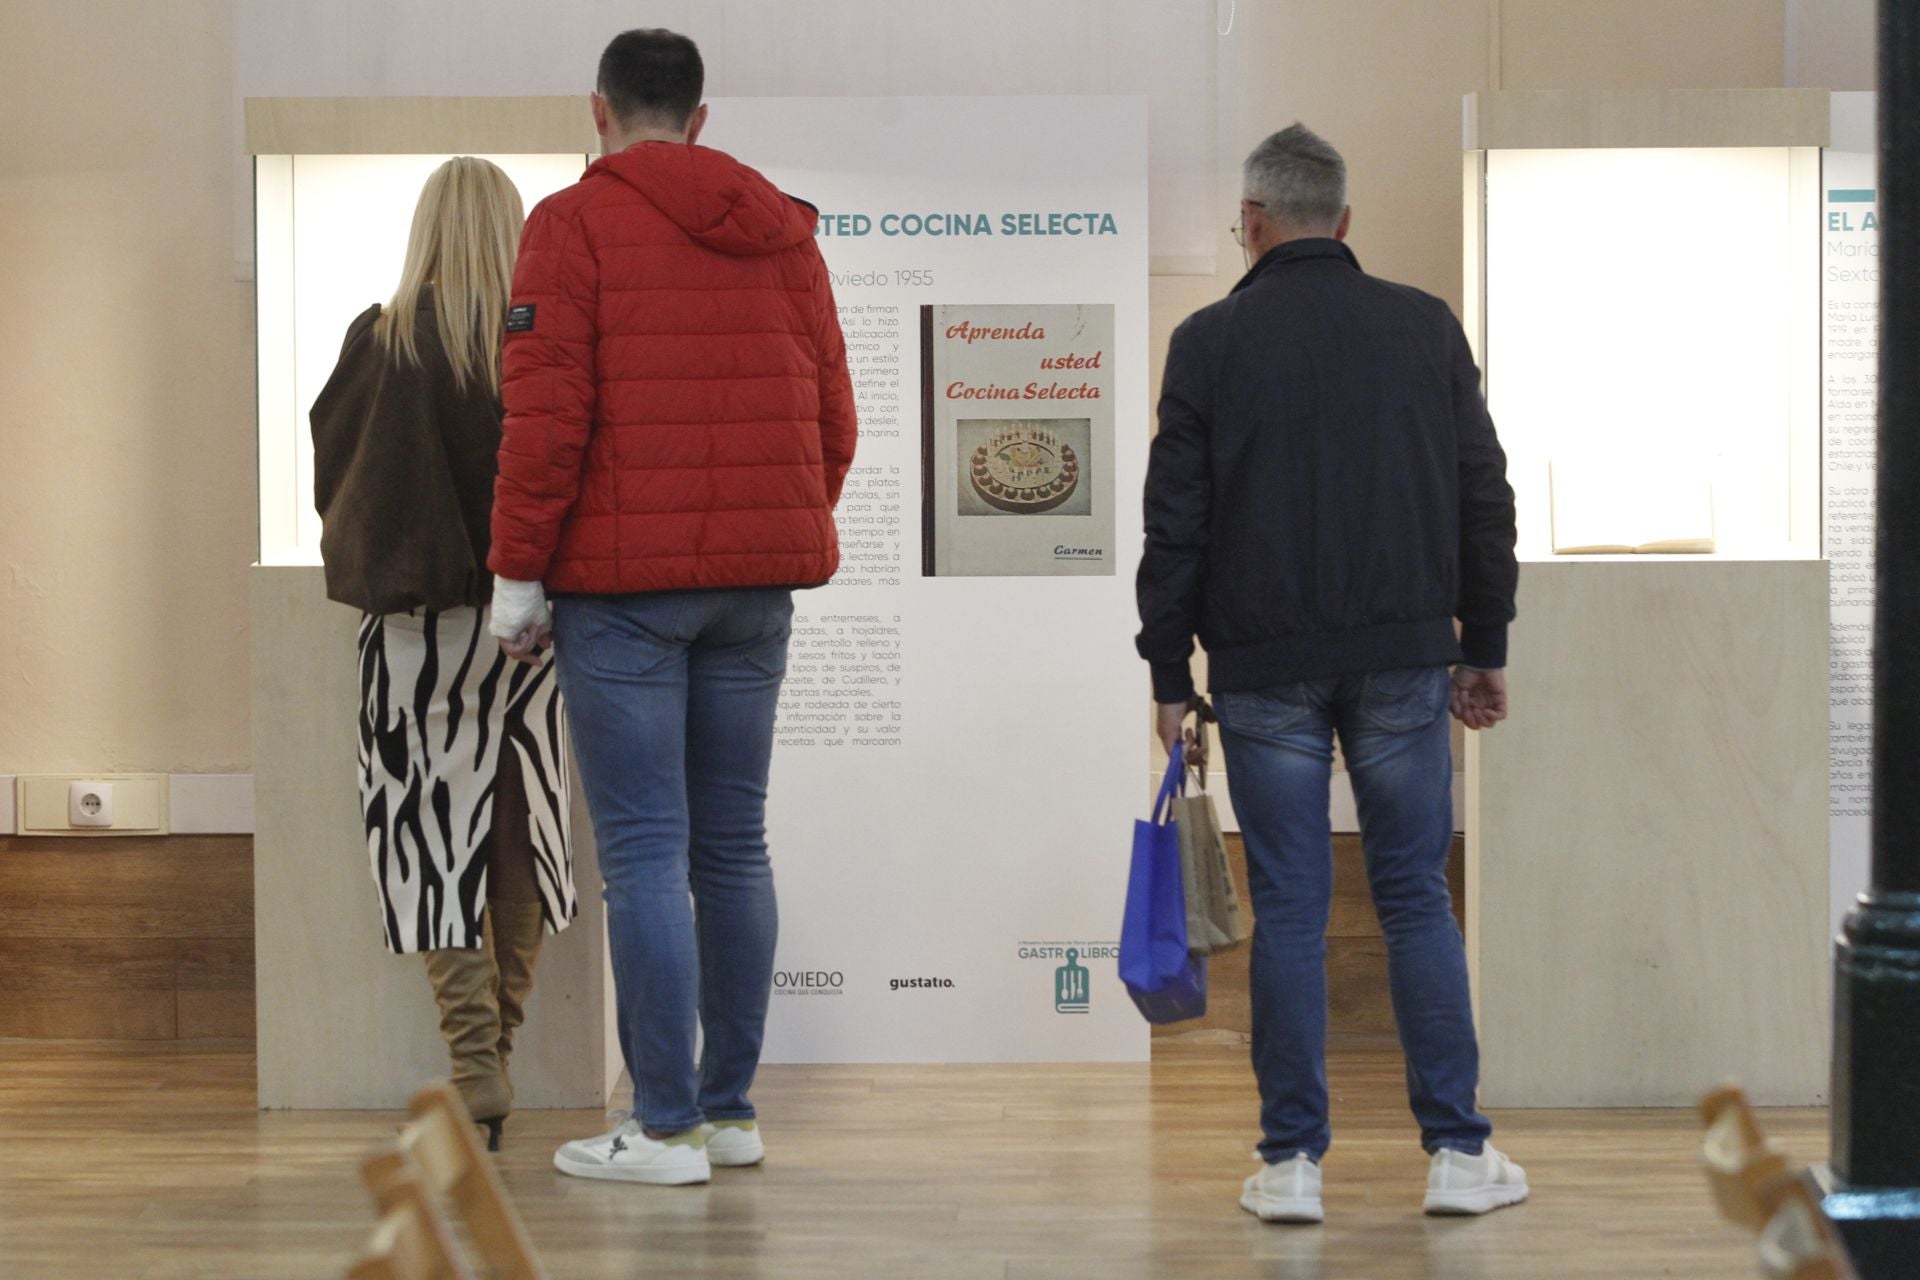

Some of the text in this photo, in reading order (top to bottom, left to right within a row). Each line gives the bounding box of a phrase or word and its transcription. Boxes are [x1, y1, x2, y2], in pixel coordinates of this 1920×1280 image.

[880, 213, 992, 236] COCINA
[1000, 213, 1118, 236] SELECTA
[1828, 211, 1879, 231] EL A
[894, 270, 934, 286] 1955
[851, 304, 864, 313] de
[867, 304, 899, 313] firman
[879, 317, 899, 326] hizo
[945, 320, 1046, 345] Aprenda
[1828, 324, 1847, 334] 1919
[1854, 326, 1867, 334] en
[1828, 337, 1861, 347] madre
[872, 353, 899, 363] estilo
[1040, 351, 1102, 370] usted
[860, 367, 899, 377] primera
[855, 379, 886, 388] define
[946, 381, 1101, 400] Cocina Selecta
[871, 391, 899, 402] inicio,
[880, 405, 899, 413] con
[1854, 401, 1868, 409] en
[1828, 413, 1841, 421] en
[867, 428, 899, 438] harina
[1828, 426, 1840, 434] su
[850, 465, 882, 475] cordar
[846, 477, 900, 489] los platos
[886, 490, 900, 500] sin
[1828, 485, 1841, 496] Su
[1844, 485, 1870, 496] obra
[847, 503, 871, 514] para
[880, 504, 900, 513] que
[876, 513, 900, 526] algo
[848, 527, 900, 538] tiempo en
[1828, 535, 1873, 545] ha sido
[1054, 544, 1104, 556] Carmen
[848, 551, 889, 561] lectores
[879, 576, 900, 586] más
[794, 613, 809, 622] los
[820, 613, 881, 624] entremeses,
[852, 625, 900, 637] hojaldres,
[792, 638, 807, 648] de
[811, 638, 852, 648] centollo
[856, 638, 889, 648] relleno
[798, 652, 826, 660] sesos
[831, 650, 856, 660] fritos
[792, 662, 901, 674] tipos de suspiros, de
[821, 674, 836, 685] de
[841, 674, 888, 686] Cudillero,
[790, 687, 820, 697] tartas
[822, 687, 874, 699] nupciales.
[804, 699, 849, 709] rodeada
[853, 699, 867, 709] de
[871, 699, 901, 709] cierto
[786, 711, 847, 721] información
[855, 711, 883, 721] sobre
[875, 723, 901, 734] valor
[778, 737, 901, 748] recetas que marcaron
[773, 971, 844, 987] OVIEDO
